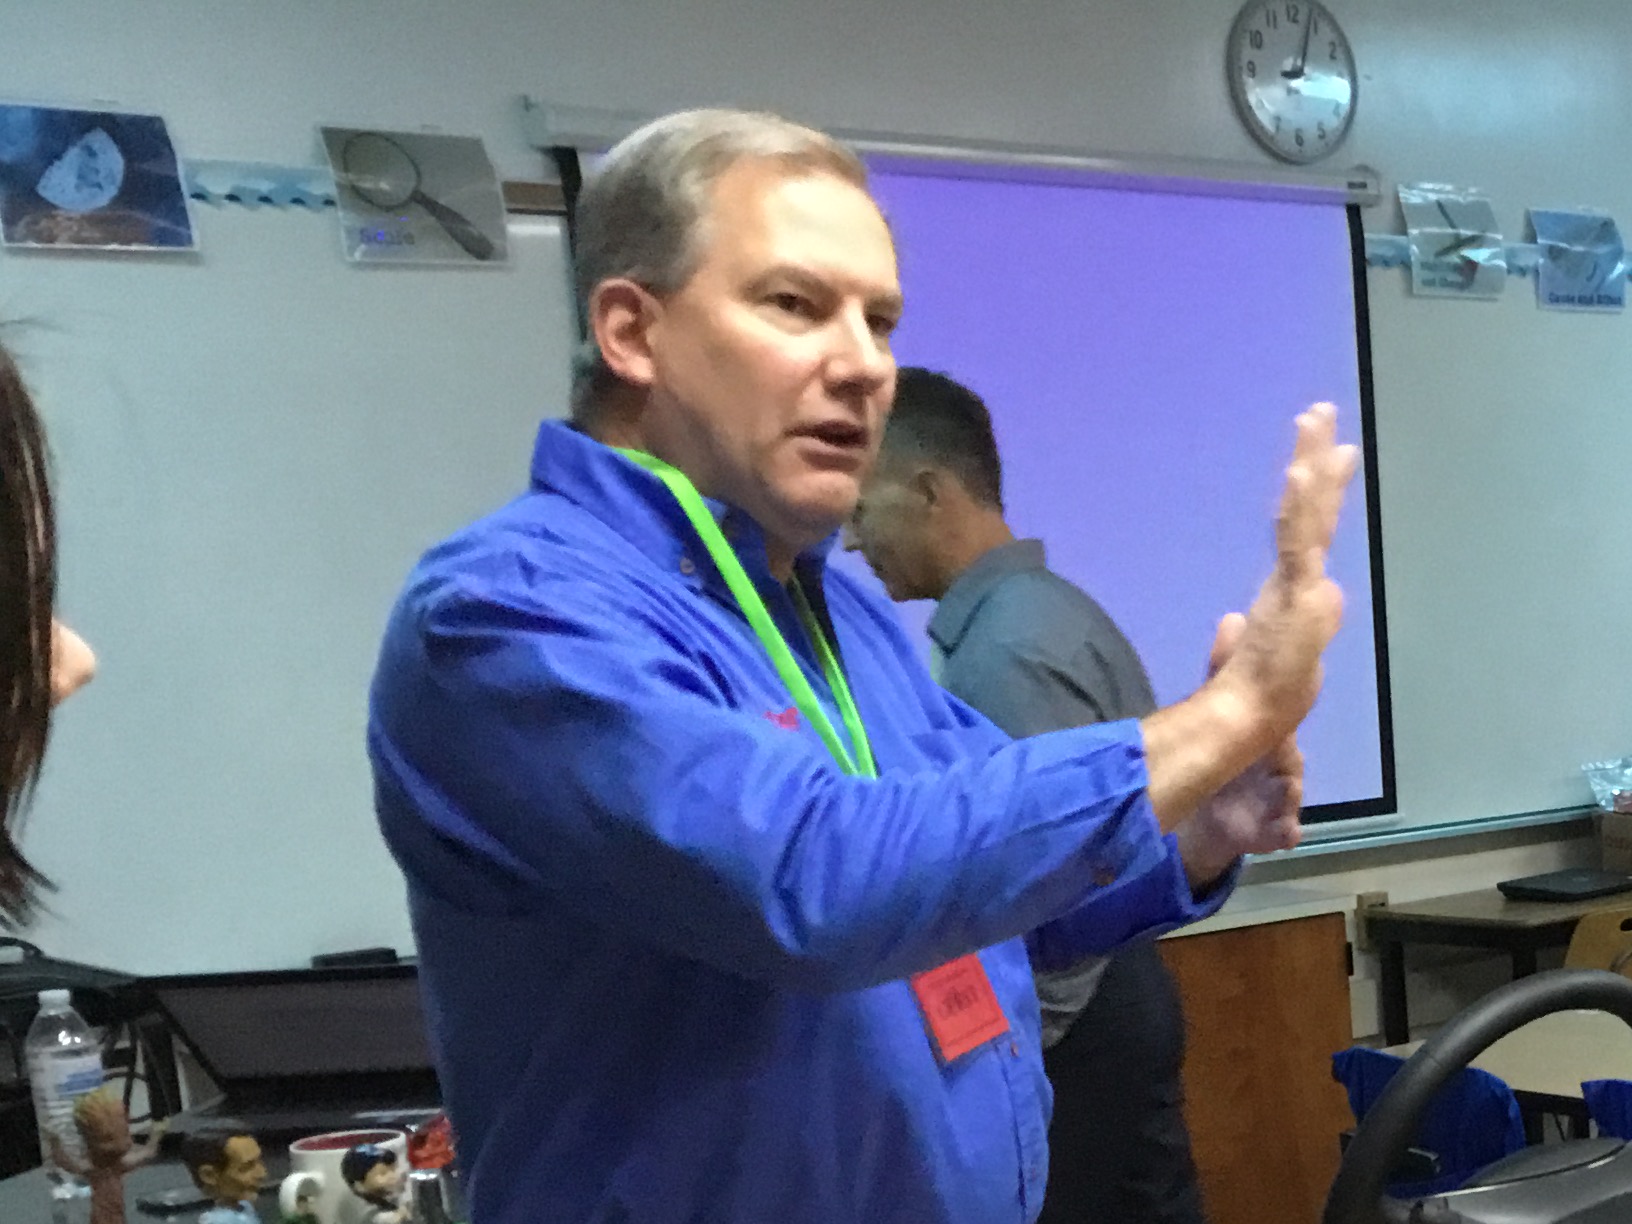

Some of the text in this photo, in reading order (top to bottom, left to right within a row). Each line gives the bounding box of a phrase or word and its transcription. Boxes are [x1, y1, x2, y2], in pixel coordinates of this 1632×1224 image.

[1266, 9, 1277, 29] 11
[1286, 4, 1299, 23] 12
[1249, 30, 1263, 49] 10
[1329, 41, 1337, 60] 2
[1247, 60, 1256, 78] 9
[1295, 128, 1304, 147] 6
[1317, 121, 1326, 139] 5
